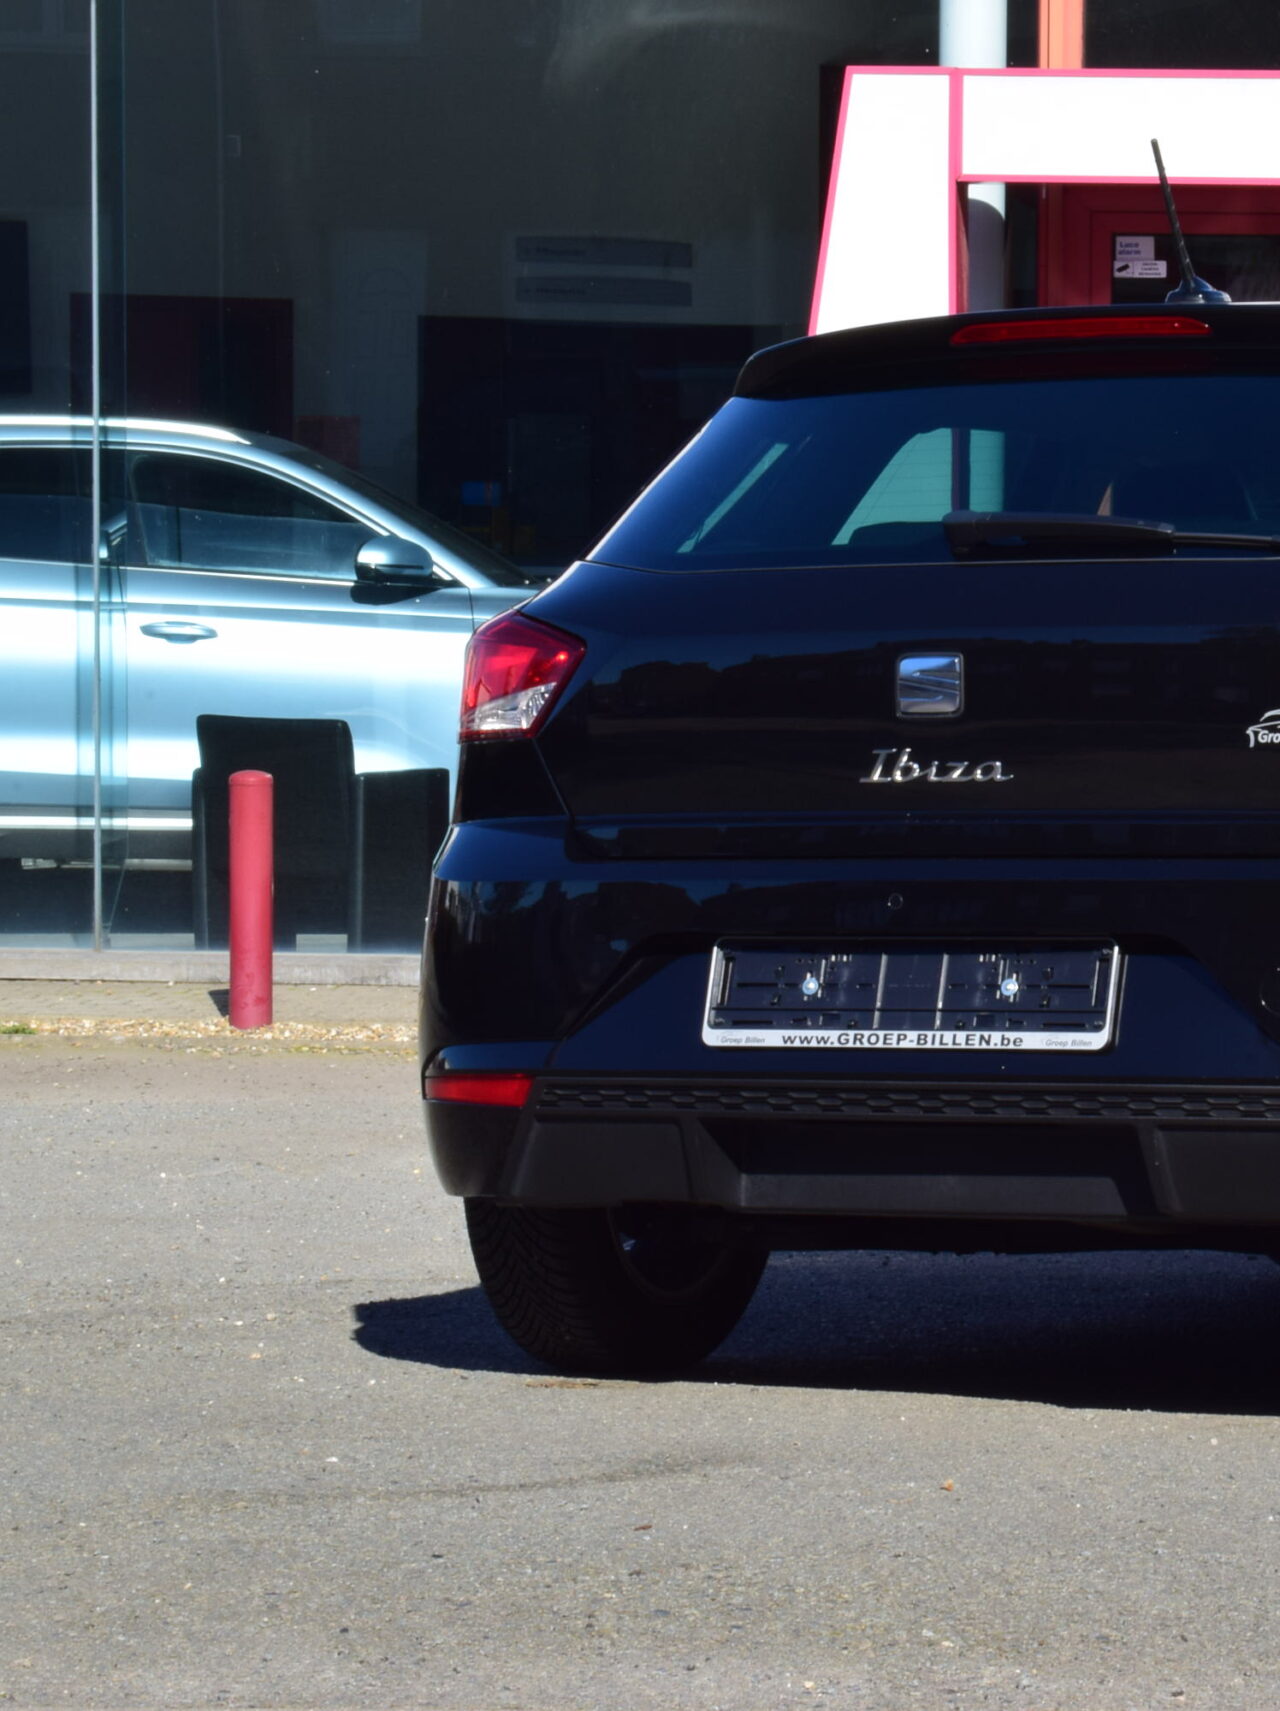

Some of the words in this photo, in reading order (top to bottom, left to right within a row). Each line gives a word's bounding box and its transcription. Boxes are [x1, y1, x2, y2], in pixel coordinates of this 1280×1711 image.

[859, 747, 1014, 783] Ibiza
[720, 1035, 742, 1045] Groep
[744, 1036, 766, 1044] Billen
[782, 1032, 1024, 1047] www.GROEP-BILLEN.be
[1045, 1038, 1069, 1048] Groep
[1070, 1039, 1093, 1047] Billen
